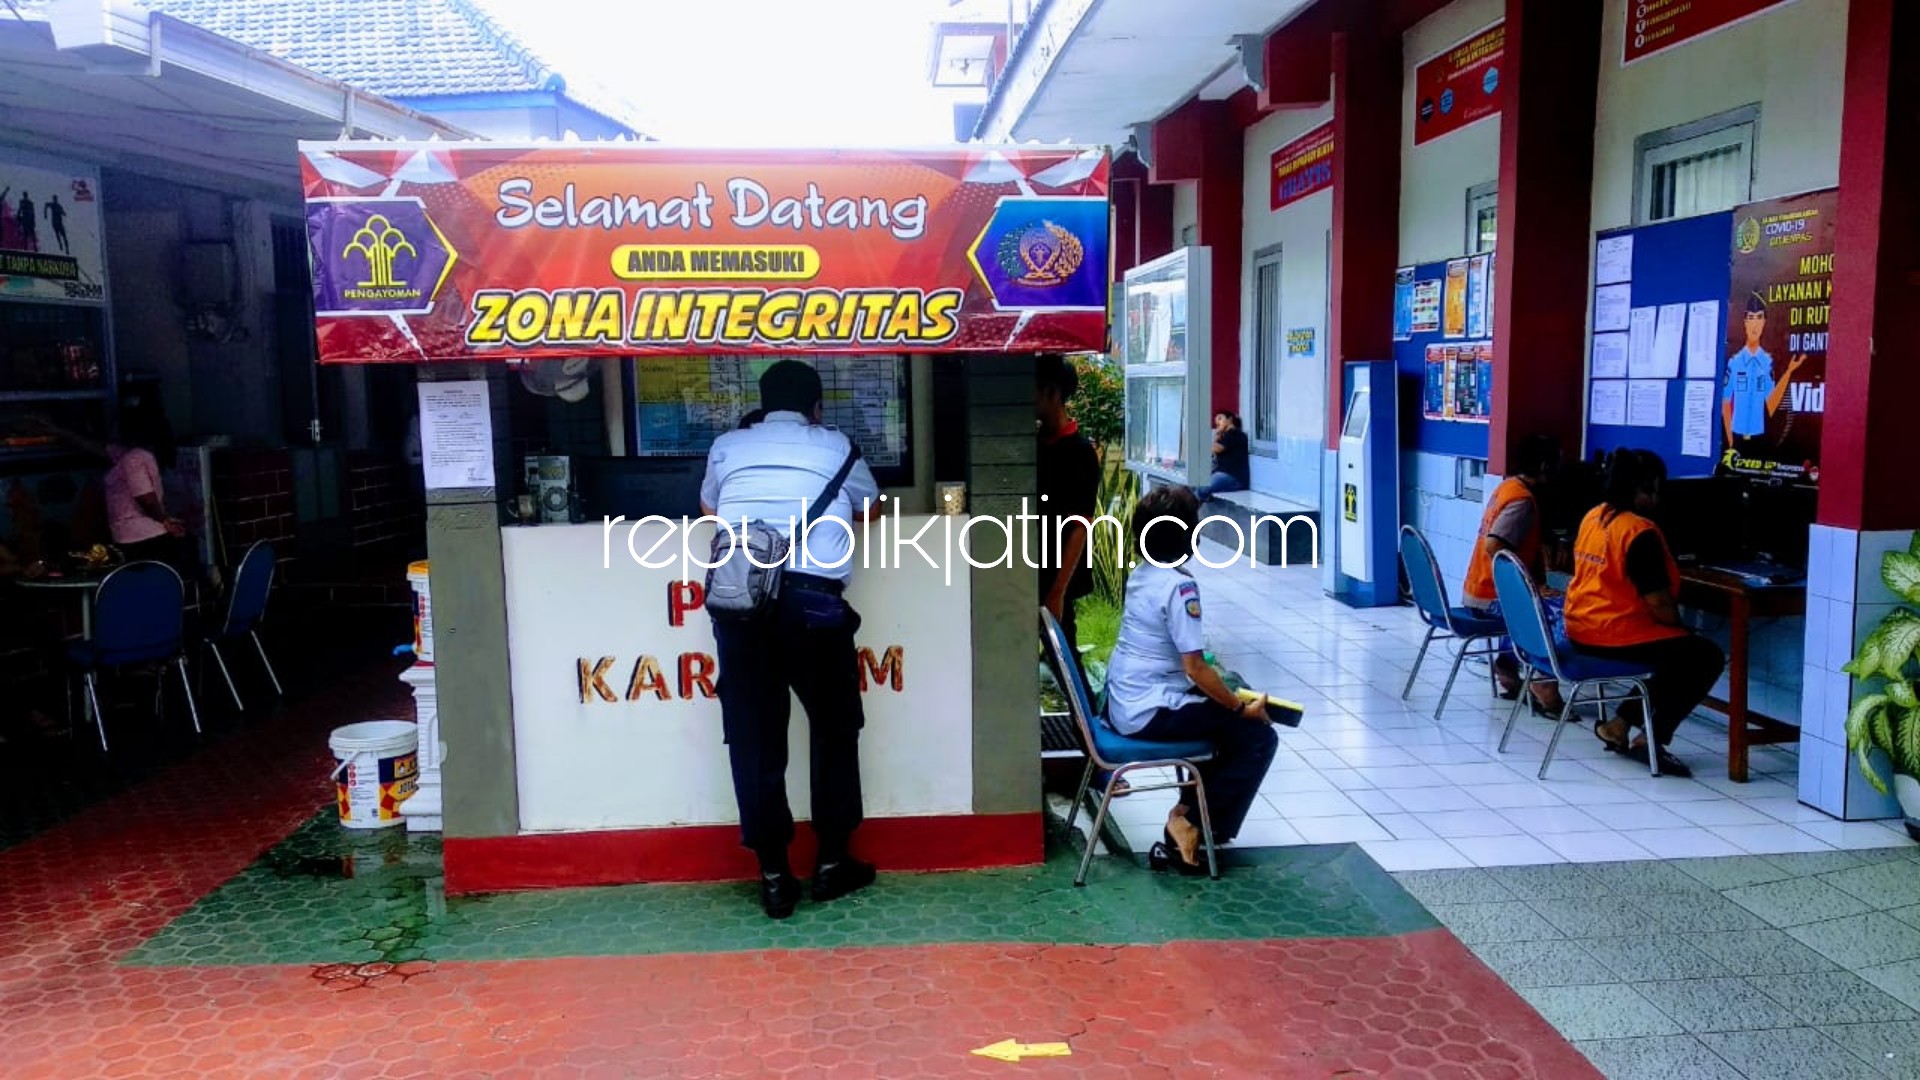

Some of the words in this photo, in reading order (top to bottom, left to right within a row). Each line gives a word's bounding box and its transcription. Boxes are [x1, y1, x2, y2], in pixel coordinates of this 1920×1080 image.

[496, 178, 713, 228] Selamat
[727, 176, 928, 239] Datang
[627, 250, 686, 273] ANDA
[690, 249, 806, 273] MEMASUKI
[344, 287, 421, 299] PENGAYOMAN
[1769, 279, 1822, 302] LAYANAN
[469, 290, 622, 343] ZONA
[631, 289, 959, 343] INTEGRITAS
[1790, 307, 1803, 326] DI
[1806, 305, 1832, 325] RUT
[1789, 333, 1801, 352] DI
[1803, 331, 1829, 351] GANT
[1790, 382, 1825, 413] Vid
[577, 645, 904, 704] KARM
